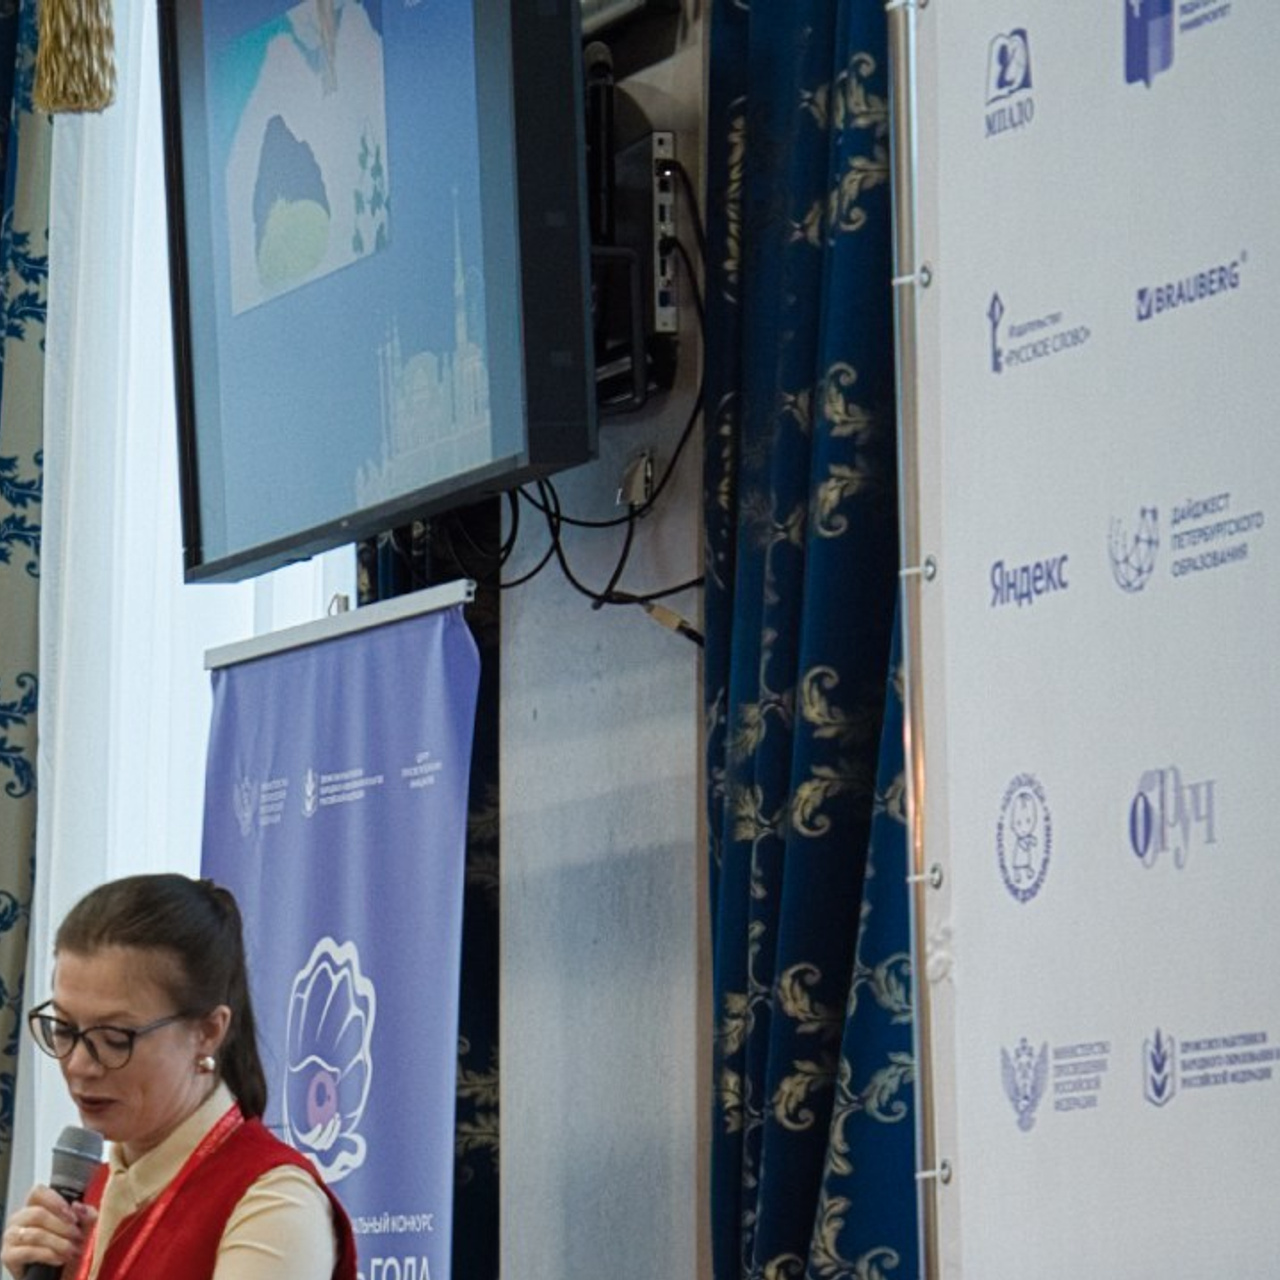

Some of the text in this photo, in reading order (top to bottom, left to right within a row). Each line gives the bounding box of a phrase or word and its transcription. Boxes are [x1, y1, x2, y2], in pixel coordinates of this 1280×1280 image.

[1155, 261, 1240, 313] BRAUBERG
[989, 554, 1069, 609] Яндекс
[391, 1212, 434, 1235] КОНКУРС
